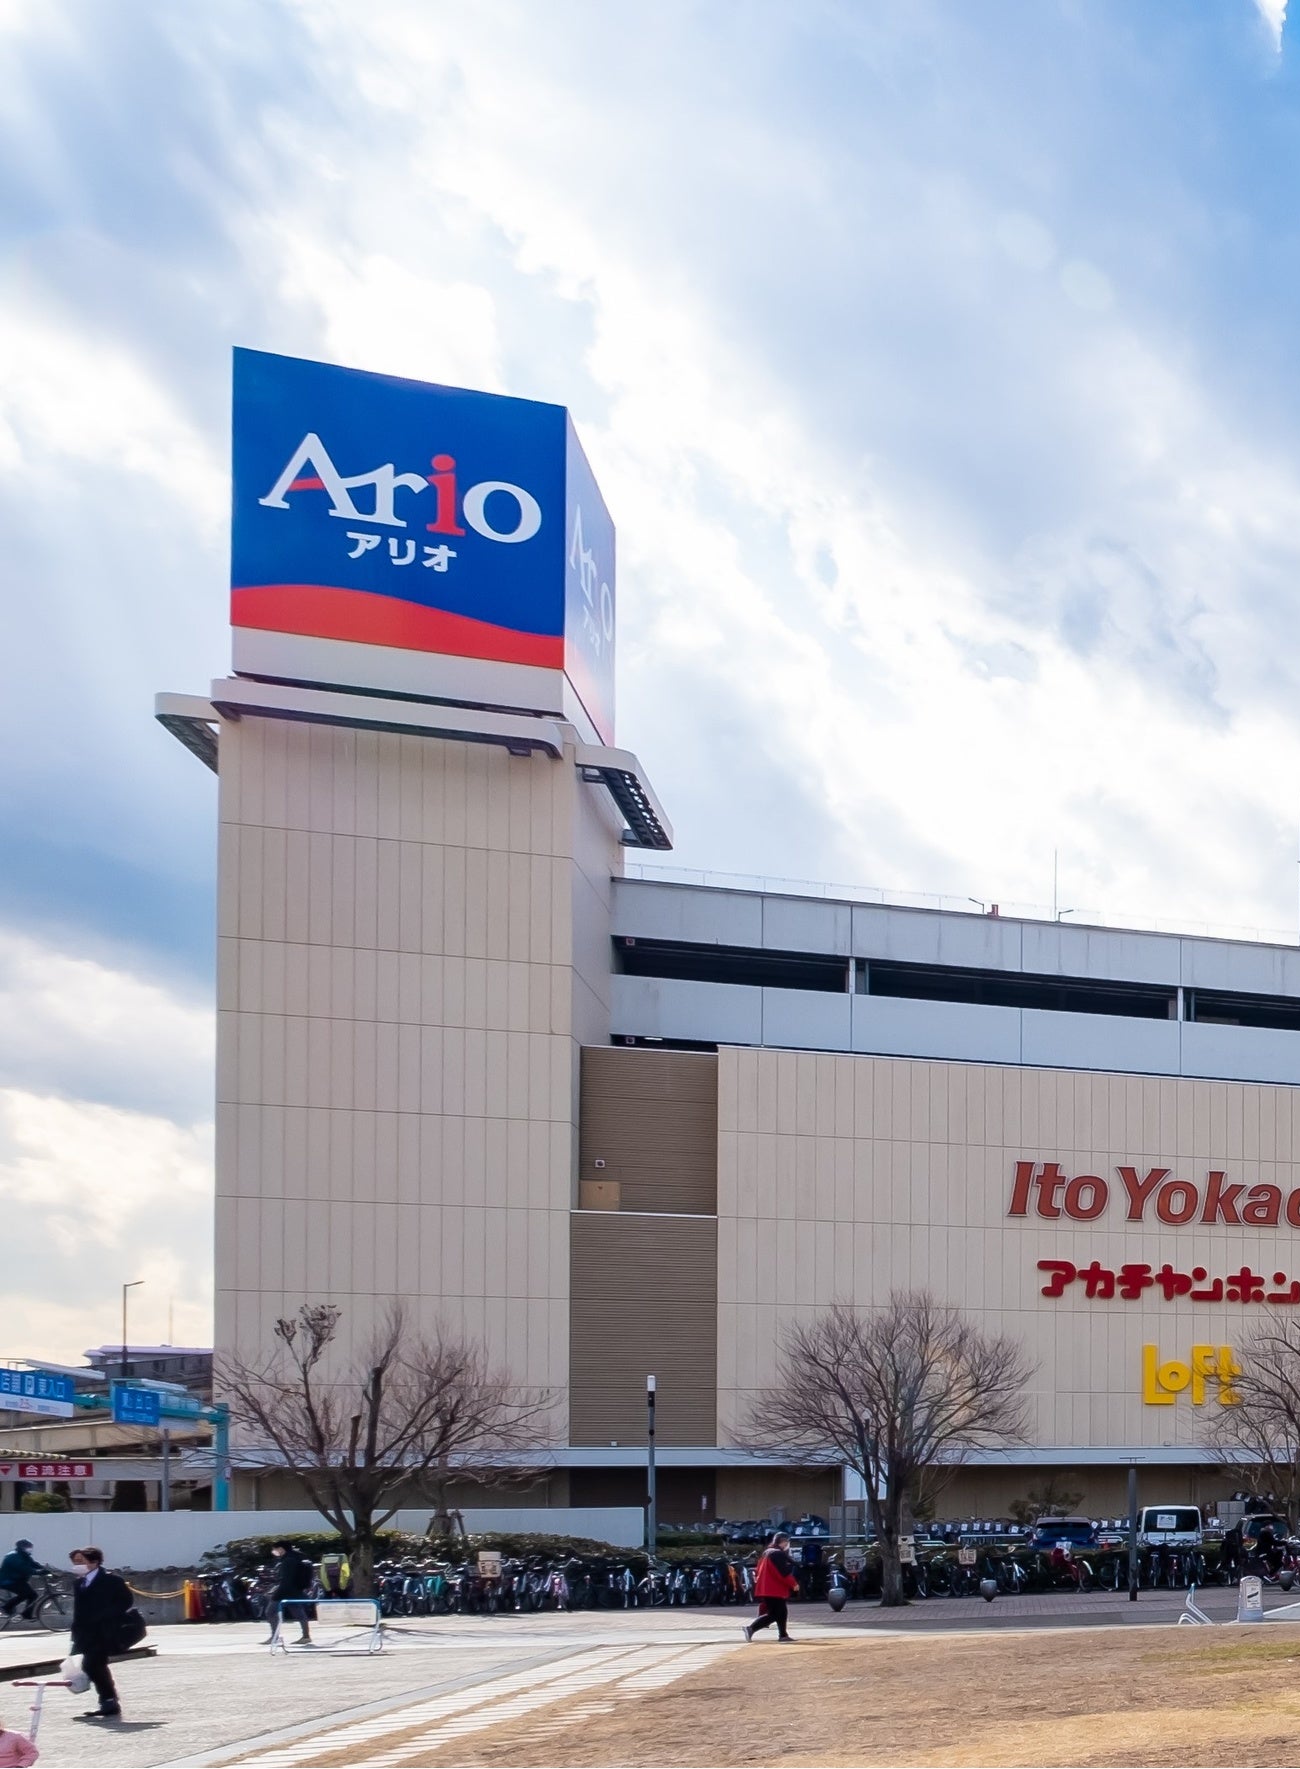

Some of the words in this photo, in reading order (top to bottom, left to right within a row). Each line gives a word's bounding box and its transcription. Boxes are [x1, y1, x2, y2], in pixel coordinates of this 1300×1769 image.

[258, 432, 542, 543] Ario
[346, 531, 458, 572] アリオ
[570, 503, 613, 642] Aro
[1007, 1160, 1110, 1221] Ito
[25, 1465, 88, 1477] 合流注意
